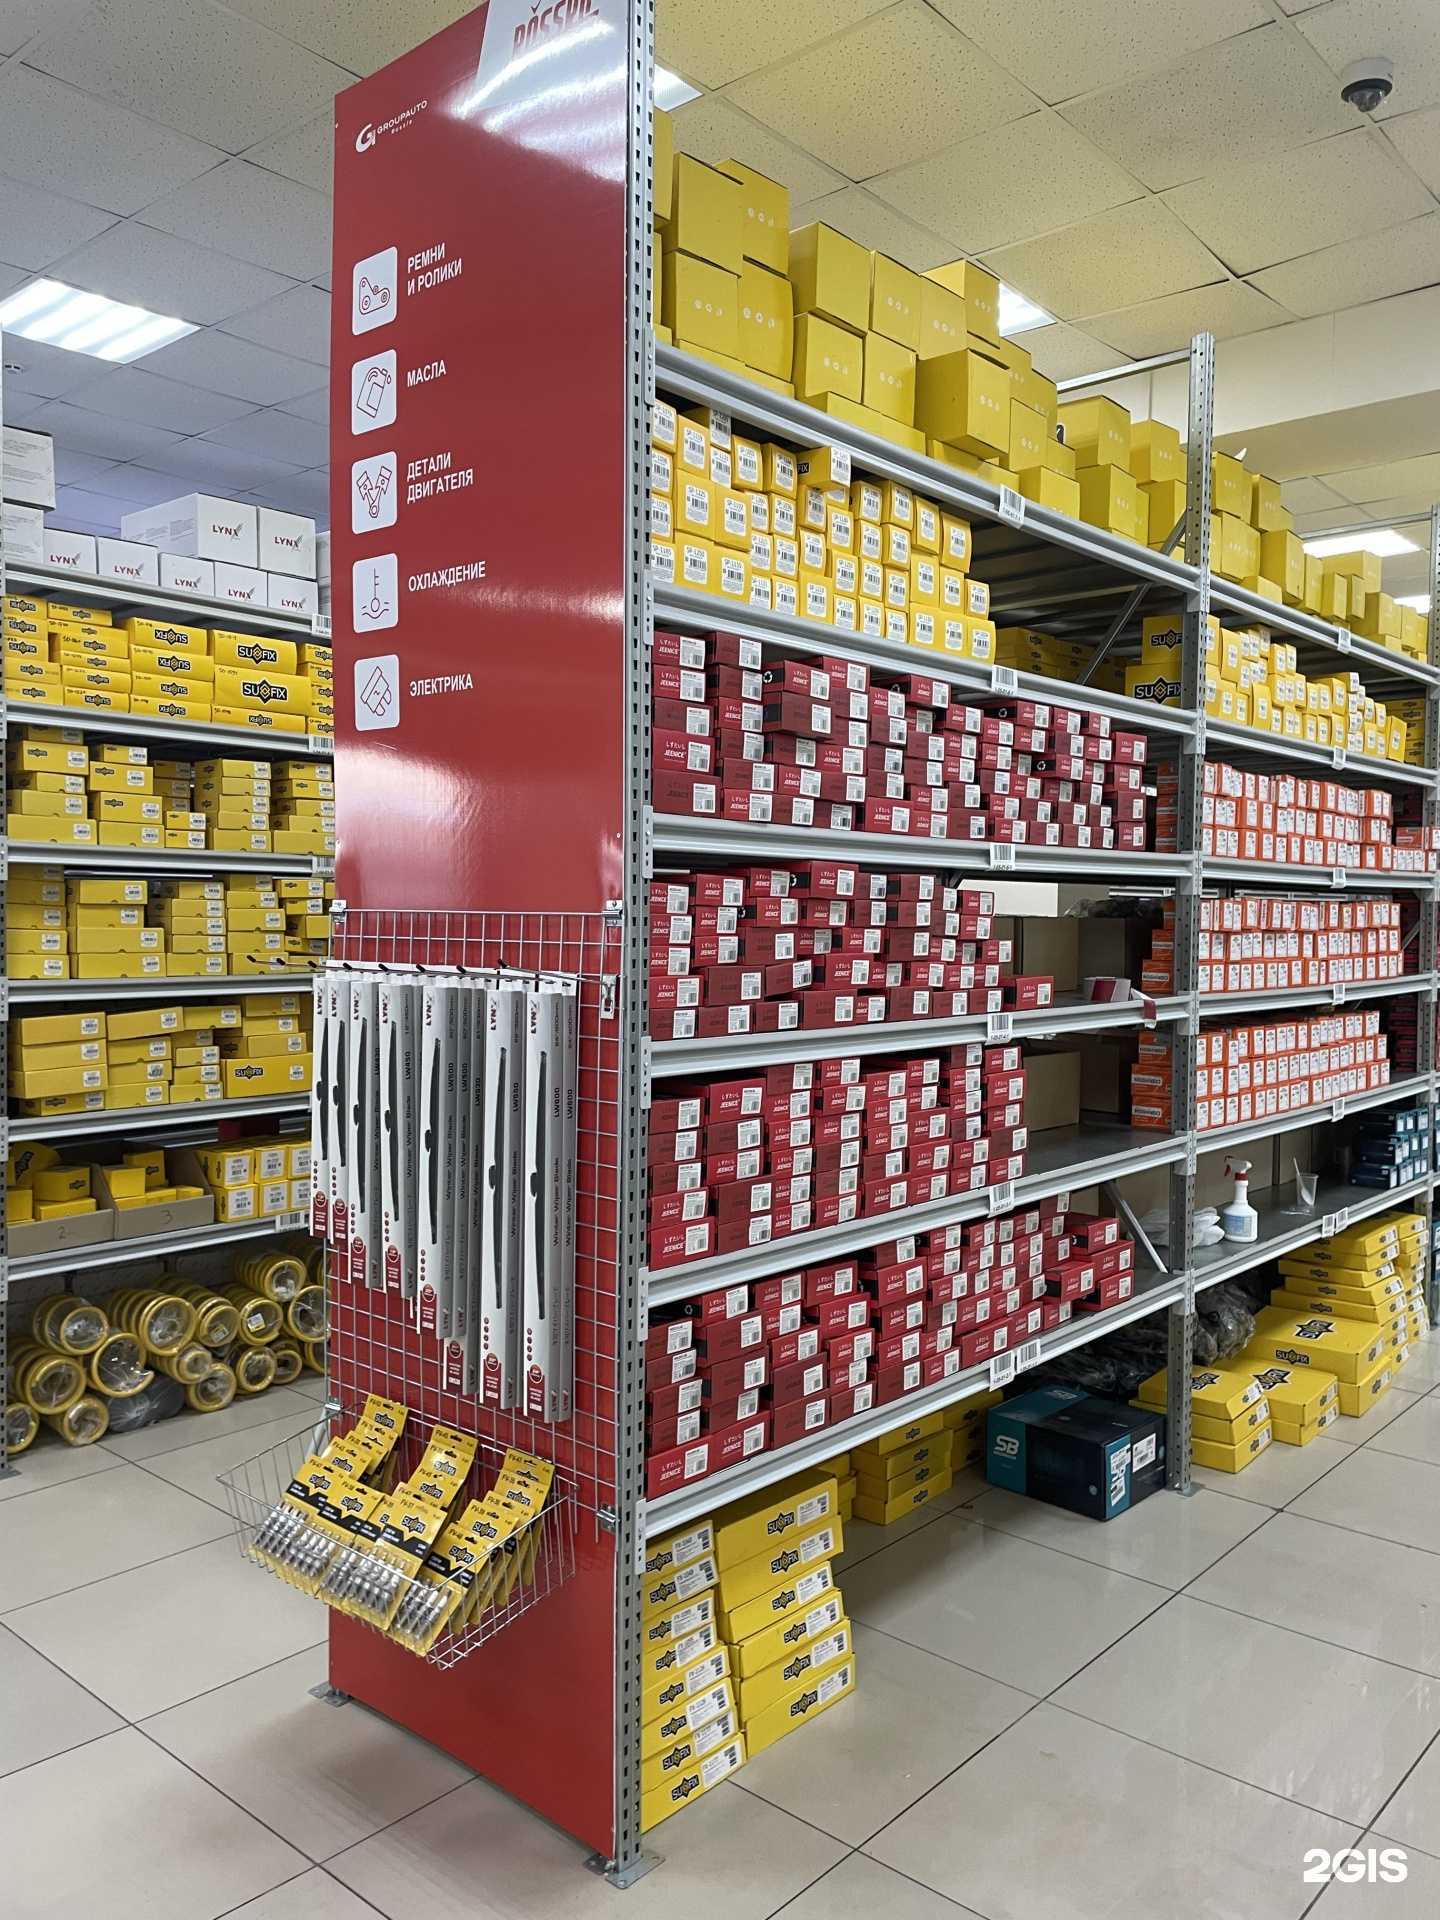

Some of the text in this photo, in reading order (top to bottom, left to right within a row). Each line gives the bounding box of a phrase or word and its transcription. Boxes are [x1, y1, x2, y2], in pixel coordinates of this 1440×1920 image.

[377, 100, 427, 134] GROUPAUTO
[407, 243, 446, 274] РЕМНИ
[407, 258, 462, 296] И РОЛИКИ
[407, 360, 447, 387] МАСЛА
[407, 452, 451, 482] ДЕТАЛИ
[407, 468, 474, 504] ДВИГАТЕЛЯ
[212, 523, 241, 538] LYNX
[274, 535, 302, 549] LYNX
[50, 554, 79, 566] LYNX
[114, 565, 141, 577] LYNX
[175, 577, 200, 589] LYNX
[408, 561, 486, 592] ОХЛАЖДЕНИЕ
[228, 588, 253, 600] LYNX
[281, 599, 305, 609] LYNX
[155, 629, 188, 643] SUFIX
[159, 657, 190, 669] SUFIX
[238, 645, 277, 661] SUFIX
[243, 683, 288, 700] SUFIX
[410, 673, 473, 696] ЭЛЕКТРИКА
[161, 1210, 172, 1224] 3
[1276, 1350, 1309, 1364] SUFIX
[994, 1434, 1020, 1456] SB
[402, 1515, 425, 1533] SUFIX
[768, 1512, 794, 1534] SUFIX
[771, 1550, 799, 1573] SUFIX
[784, 1655, 811, 1680] SUFIX
[791, 1690, 817, 1716] SUFIX
[663, 1745, 691, 1770] SUFIX
[672, 1775, 700, 1800] SUFIX
